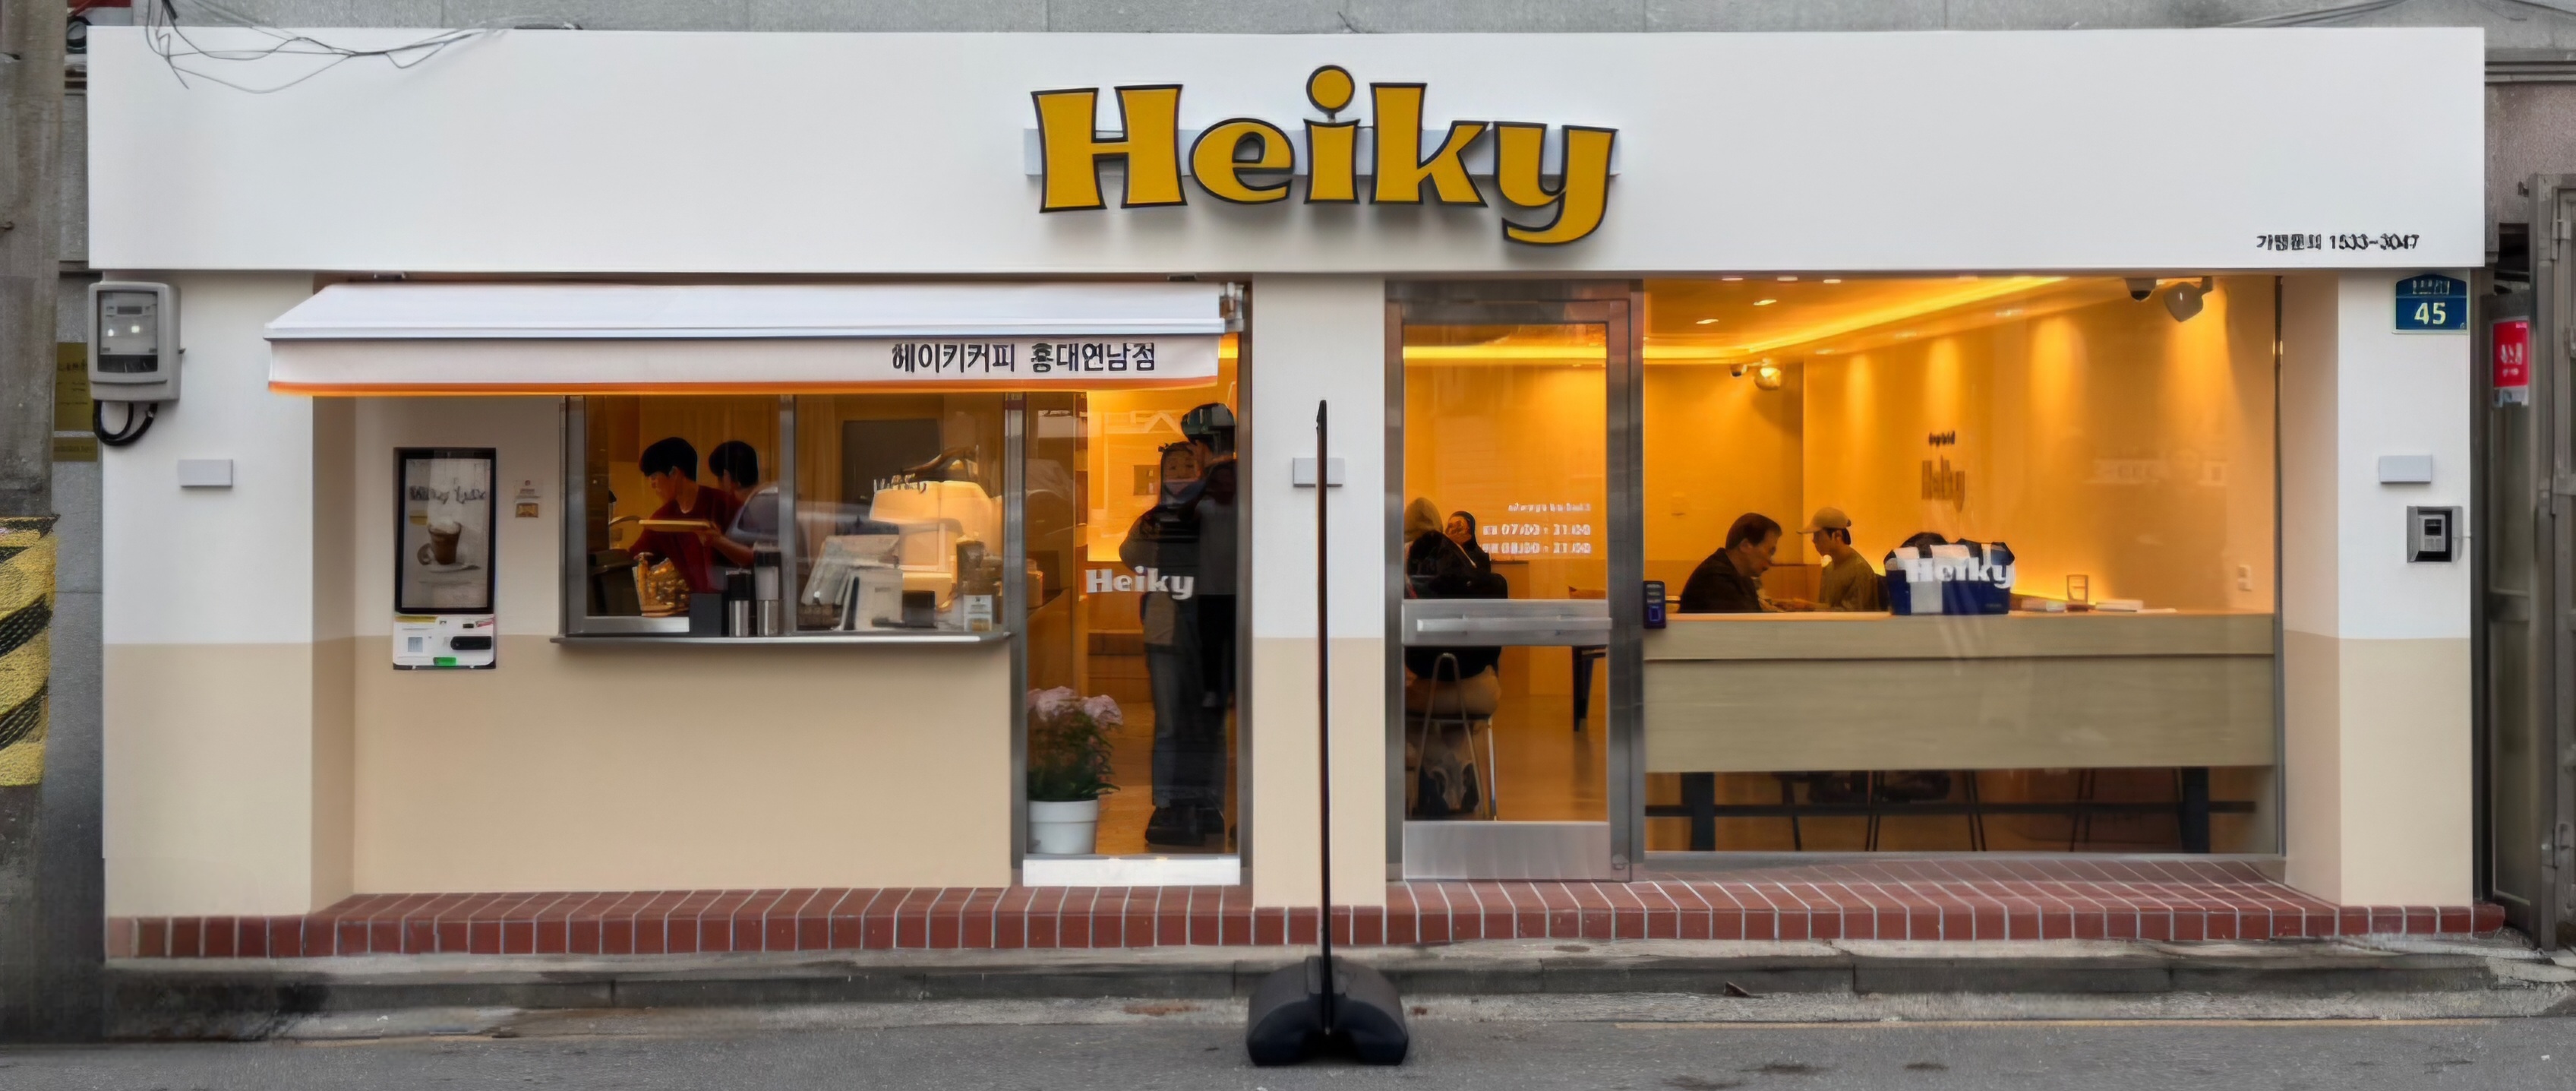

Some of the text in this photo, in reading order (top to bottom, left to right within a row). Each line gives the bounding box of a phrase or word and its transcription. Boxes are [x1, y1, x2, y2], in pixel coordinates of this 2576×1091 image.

[1030, 64, 1618, 244] Heiky
[2414, 302, 2447, 325] 45
[892, 342, 1155, 372] 헤이키커피 홍대연남점
[1085, 565, 1195, 600] Heiky
